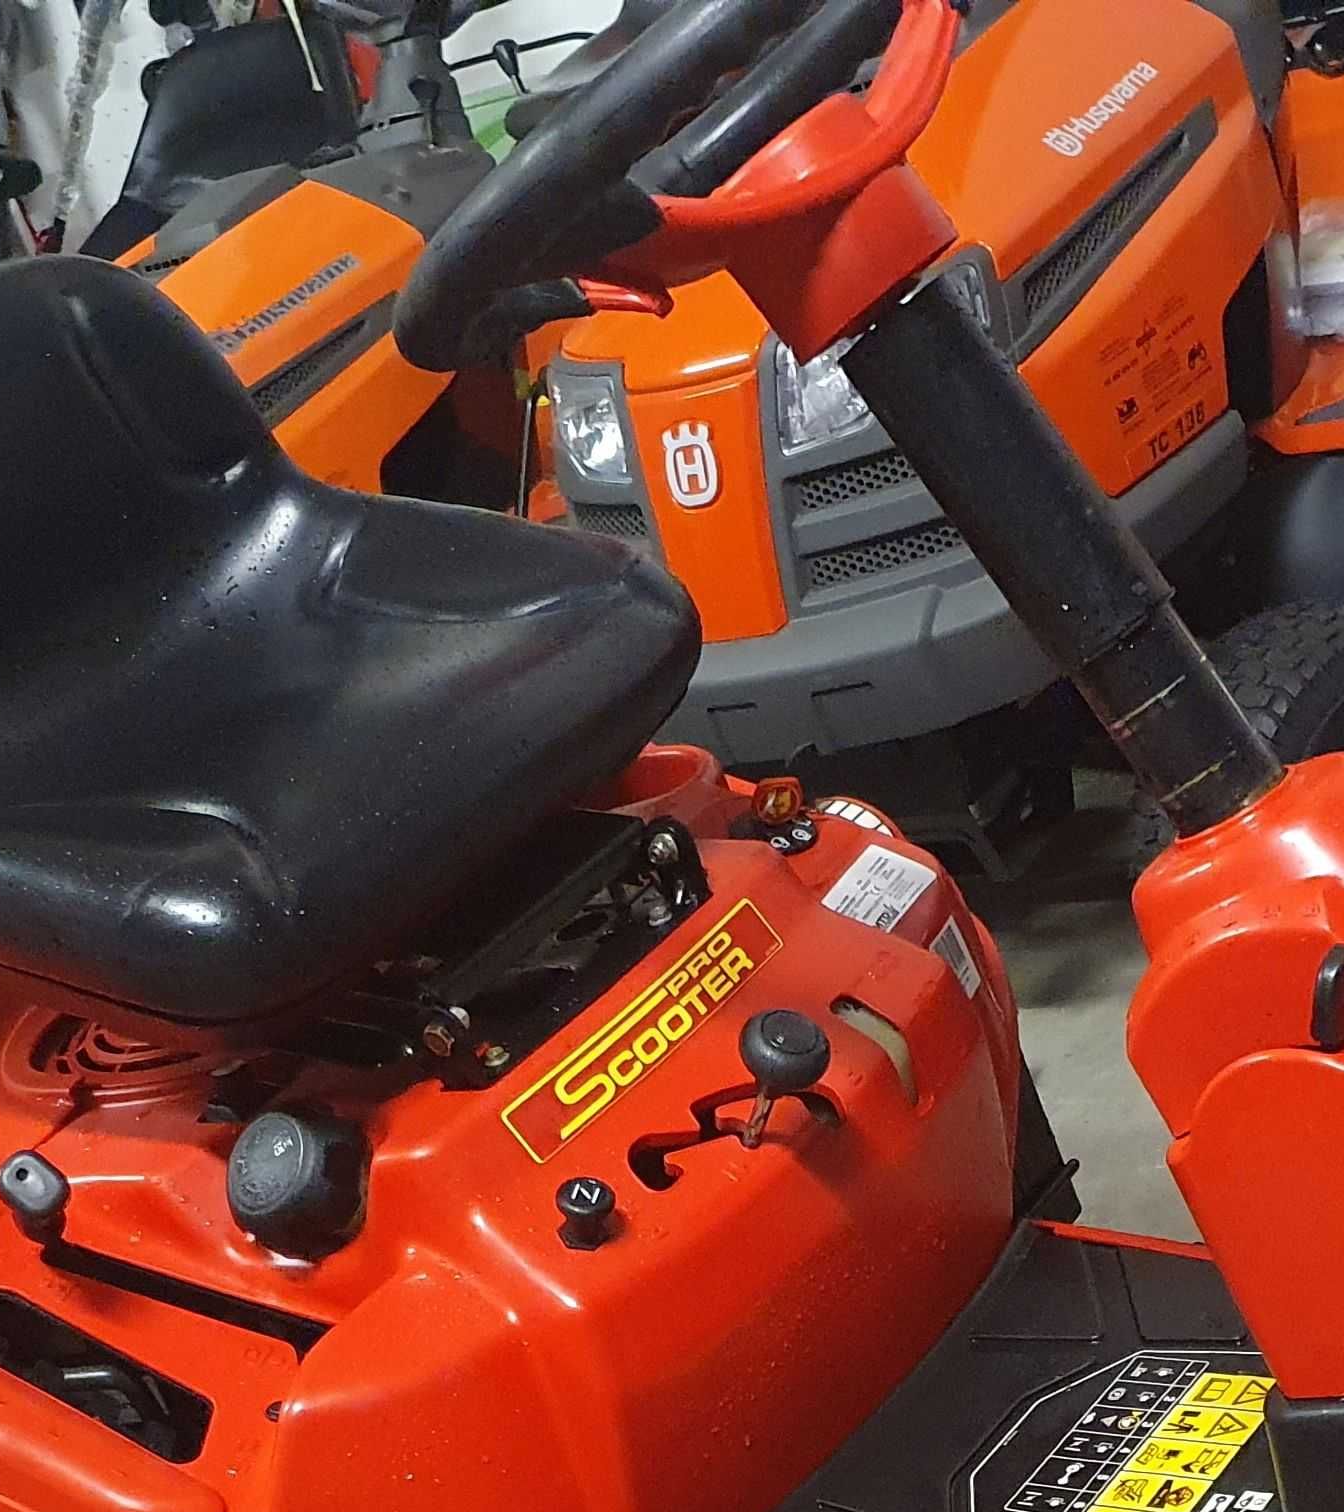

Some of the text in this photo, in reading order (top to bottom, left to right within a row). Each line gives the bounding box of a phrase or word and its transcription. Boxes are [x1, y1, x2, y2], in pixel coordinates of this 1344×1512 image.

[1060, 61, 1158, 141] Husqvarna
[1147, 430, 1169, 460] TC
[665, 931, 733, 997] PRO
[554, 946, 755, 1141] SCOOTER
